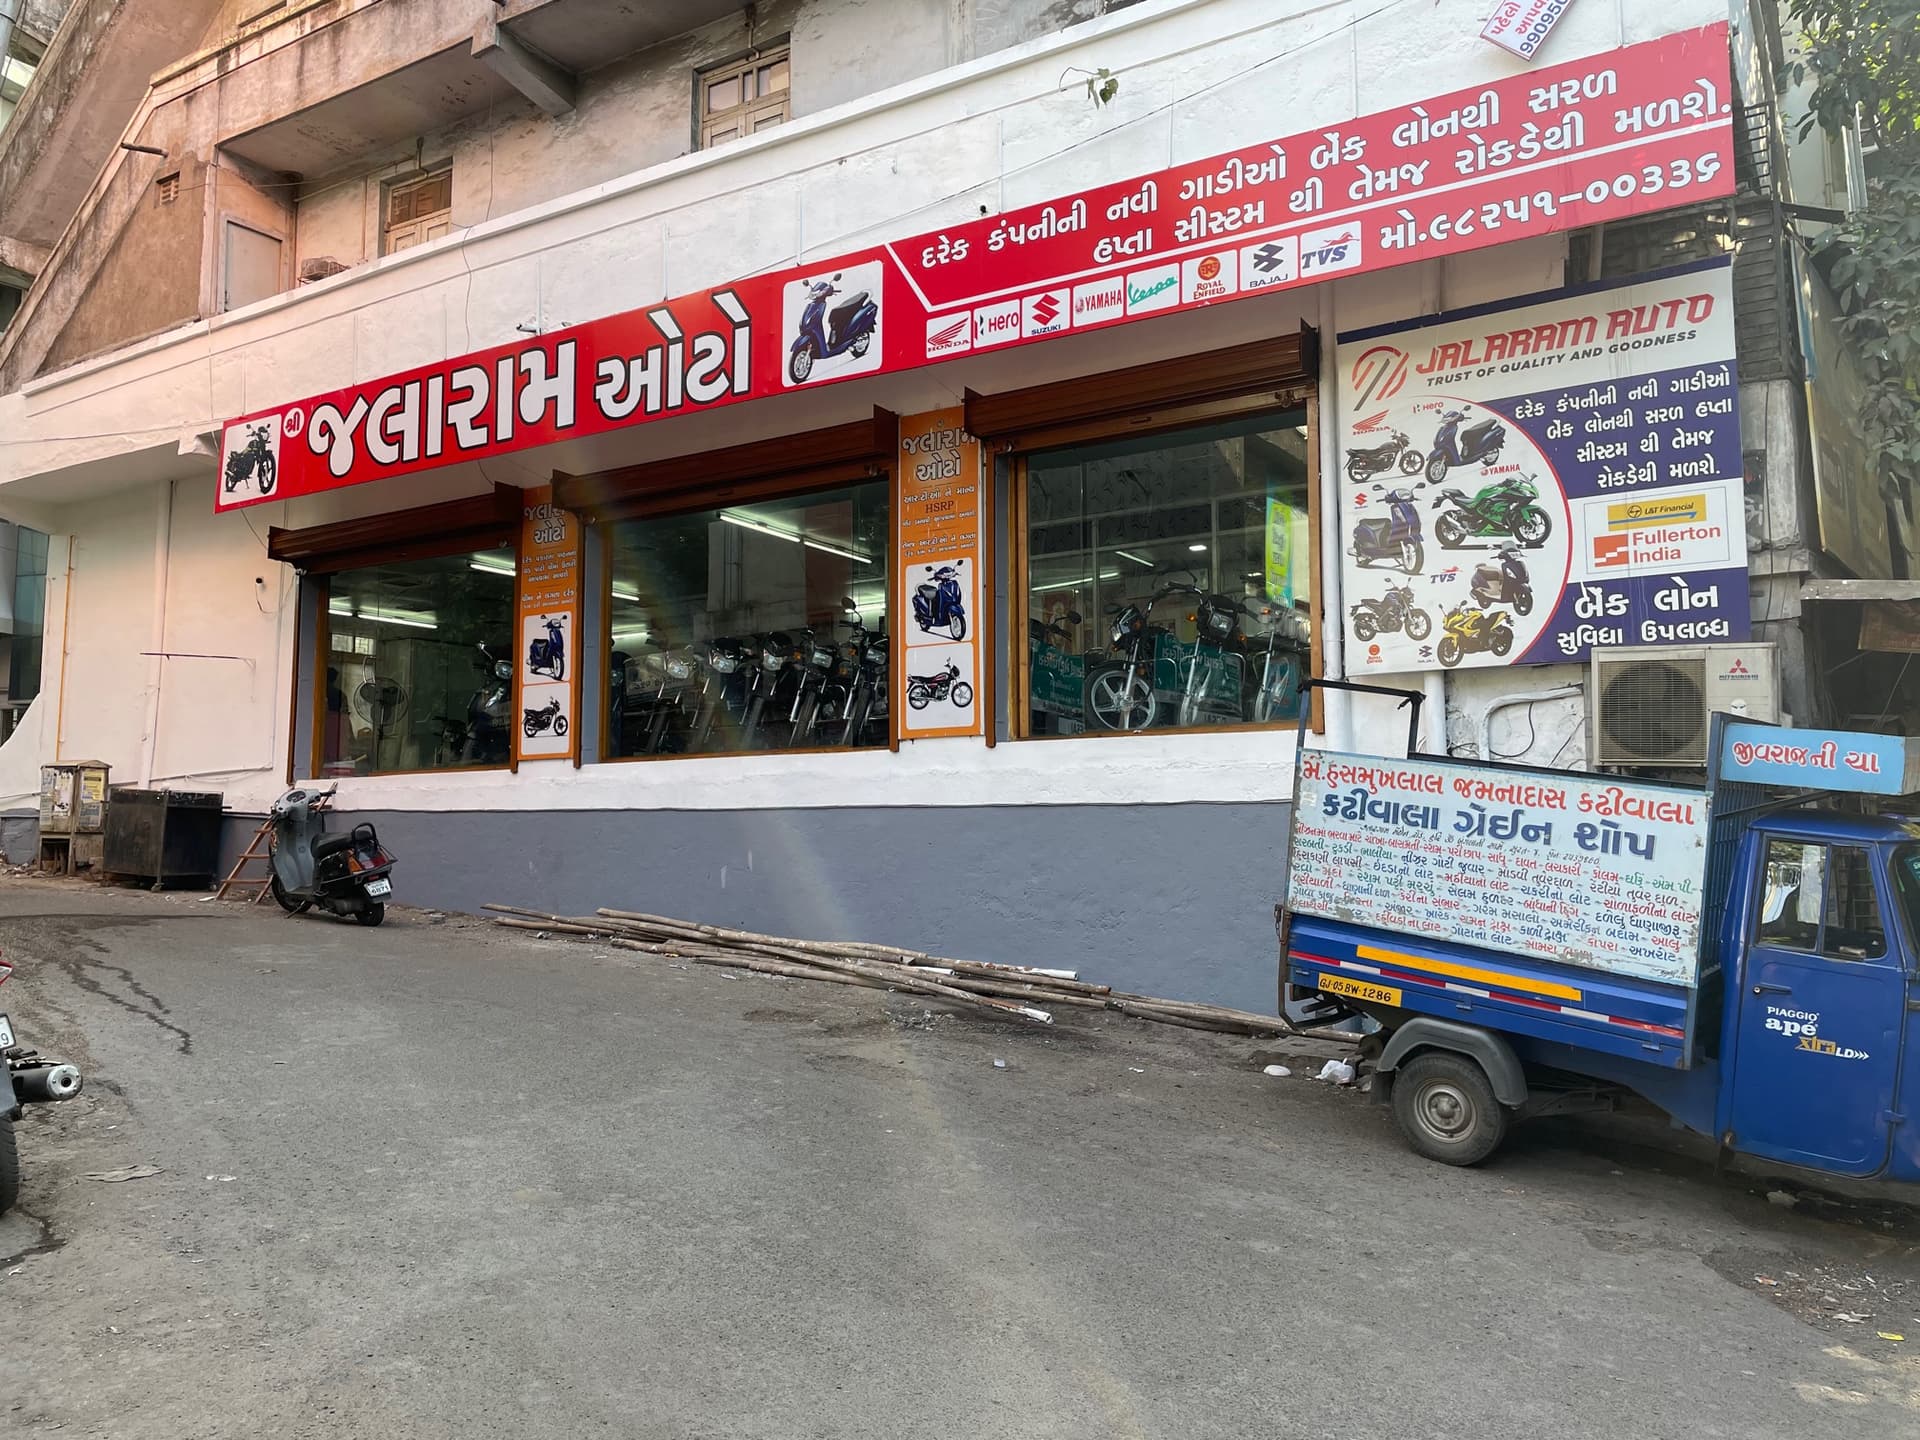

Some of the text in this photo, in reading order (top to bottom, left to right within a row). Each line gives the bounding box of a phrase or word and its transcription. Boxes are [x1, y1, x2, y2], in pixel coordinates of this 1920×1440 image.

[1515, 0, 1549, 35] આપવ
[921, 235, 970, 269] દરેક
[987, 198, 1087, 253] કંપનીની
[1106, 181, 1158, 222] નવી
[1179, 145, 1287, 201] ગાડીઓ
[1392, 90, 1500, 147] લોનથી
[1527, 69, 1617, 114] સરળ
[1093, 79, 1732, 264] હપ્તા સીસ્ટમ થી તેમજ રોકડેથી મળશે.
[1302, 245, 1347, 269] TVS
[1127, 277, 1178, 306] Vespa
[1196, 281, 1222, 291] ROYAL
[1249, 273, 1288, 288] BAJAJ
[1085, 289, 1122, 311] YAMAHA
[1193, 287, 1225, 300] ENFIELD
[1031, 325, 1061, 335] SUZUKI
[1415, 293, 1714, 375] JALARAM AUTO
[928, 339, 970, 352] HONDA
[1426, 330, 1697, 387] TRUST OF QUALITY AND GOODNESS
[308, 288, 751, 477] જલારામ ઓટો
[1515, 364, 1730, 420] દરેક કંપનીની નવી ગાડીઓ
[284, 411, 301, 434] શ્રી
[1585, 408, 1633, 433] લોનથી
[1644, 405, 1684, 425] સરળ
[1695, 398, 1732, 418] હપ્તા
[1576, 427, 1715, 463] સીસ્ટમ થી તેમજ
[916, 449, 961, 481] ઓટો
[1489, 463, 1521, 476] YAMAHA
[1597, 454, 1720, 489] રોકડેથી મળશે.
[523, 504, 565, 520] જલાર
[925, 500, 954, 513] HSRP
[1659, 502, 1694, 513] Financial
[534, 519, 565, 544] ઓટો
[1632, 526, 1721, 546] Fullerton
[1633, 547, 1681, 563] India
[1430, 573, 1456, 584] TVS
[1654, 576, 1718, 611] લોન
[1557, 619, 1729, 655] સુવિધા ઉપલબ્ધ
[1844, 751, 1881, 773] ચા
[1322, 788, 1439, 830] કઢીવાલા
[1453, 777, 1566, 810] જમનાદાસ
[1577, 786, 1695, 825] કઢીવાલા
[1767, 1006, 1818, 1021] PIAGGIO
